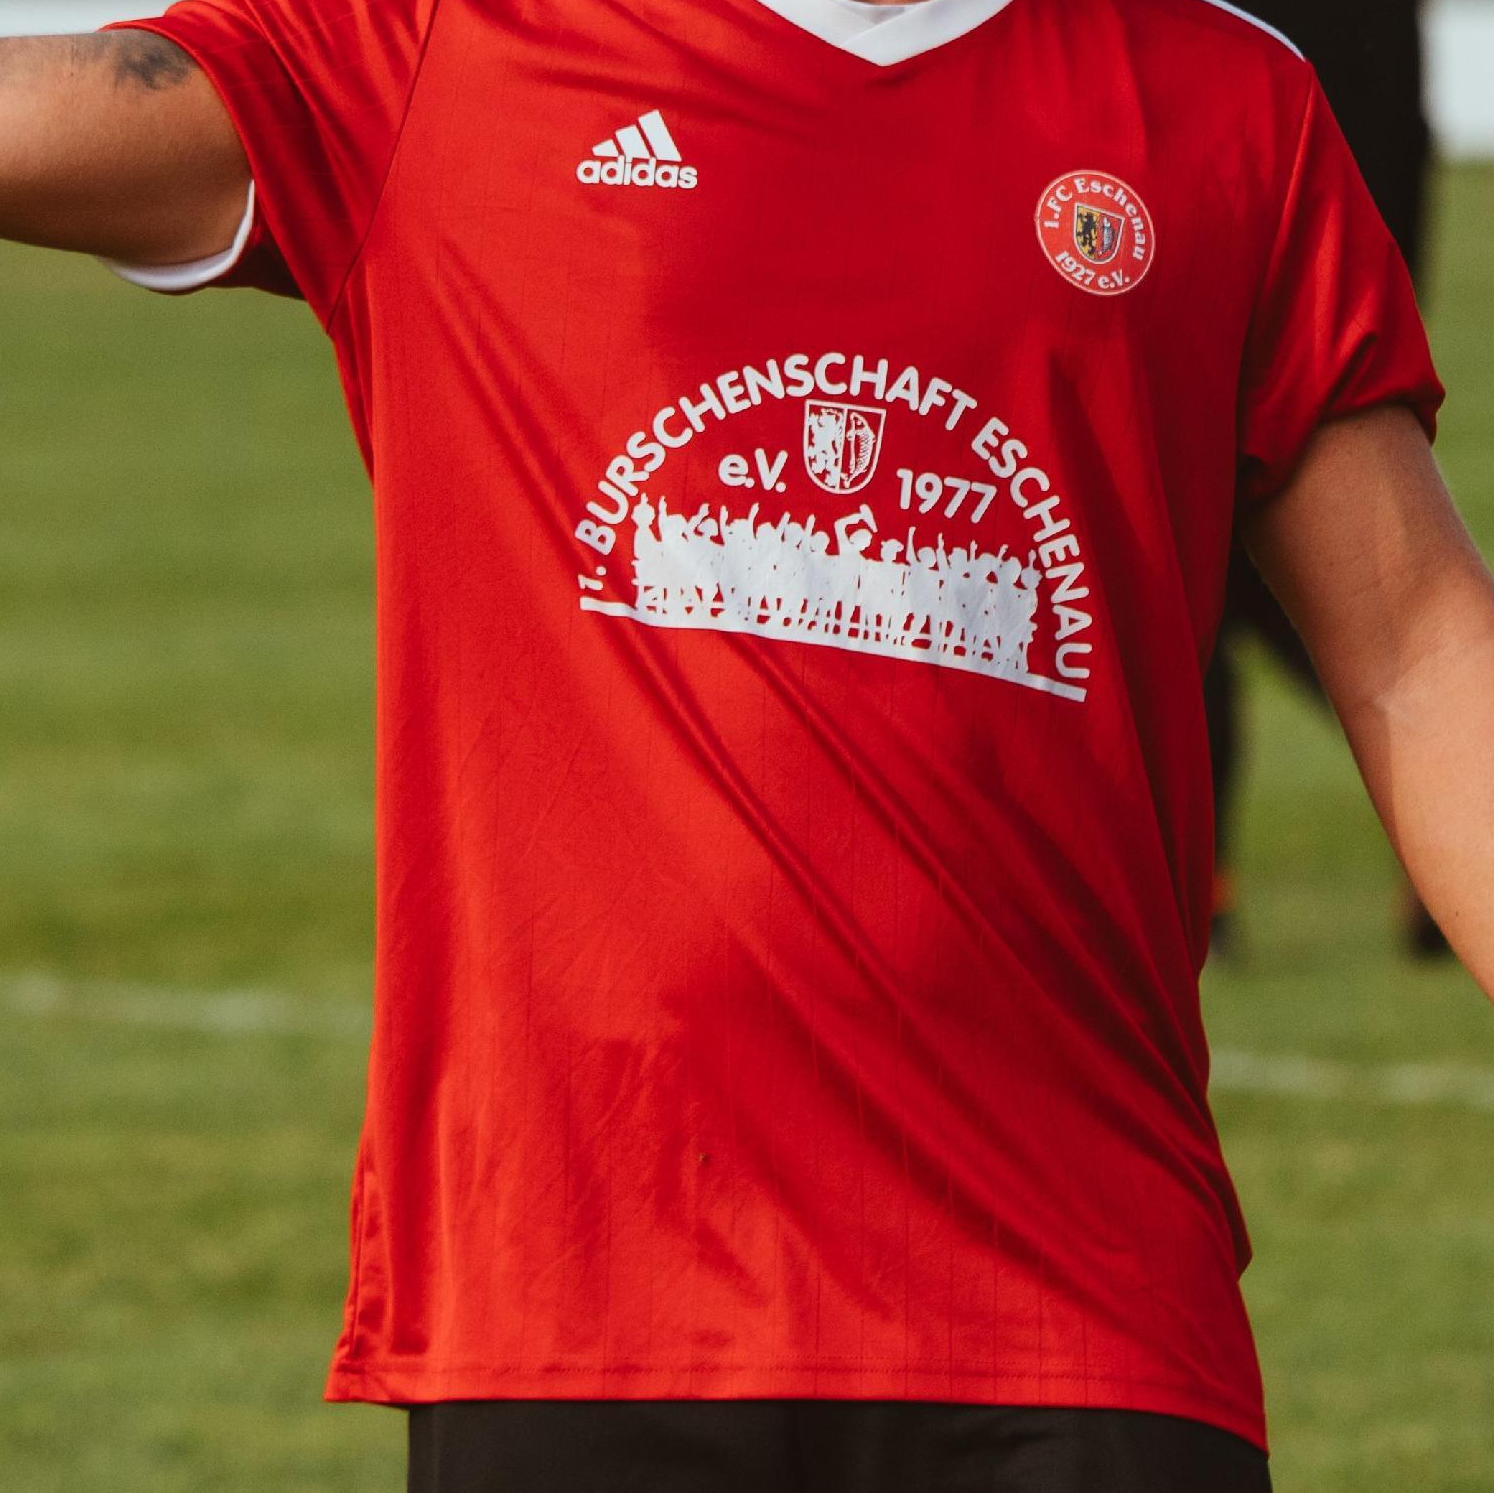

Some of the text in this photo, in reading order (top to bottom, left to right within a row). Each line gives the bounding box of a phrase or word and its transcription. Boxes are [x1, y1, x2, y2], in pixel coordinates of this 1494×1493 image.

[576, 155, 698, 189] adidas
[1073, 177, 1146, 260] Eschenau
[1056, 251, 1130, 289] 1927 e.V.
[718, 448, 790, 493] e.V.
[896, 468, 998, 522] 1977
[574, 352, 1094, 679] 1. BURSCHENSCHAFT ESCHENAU
